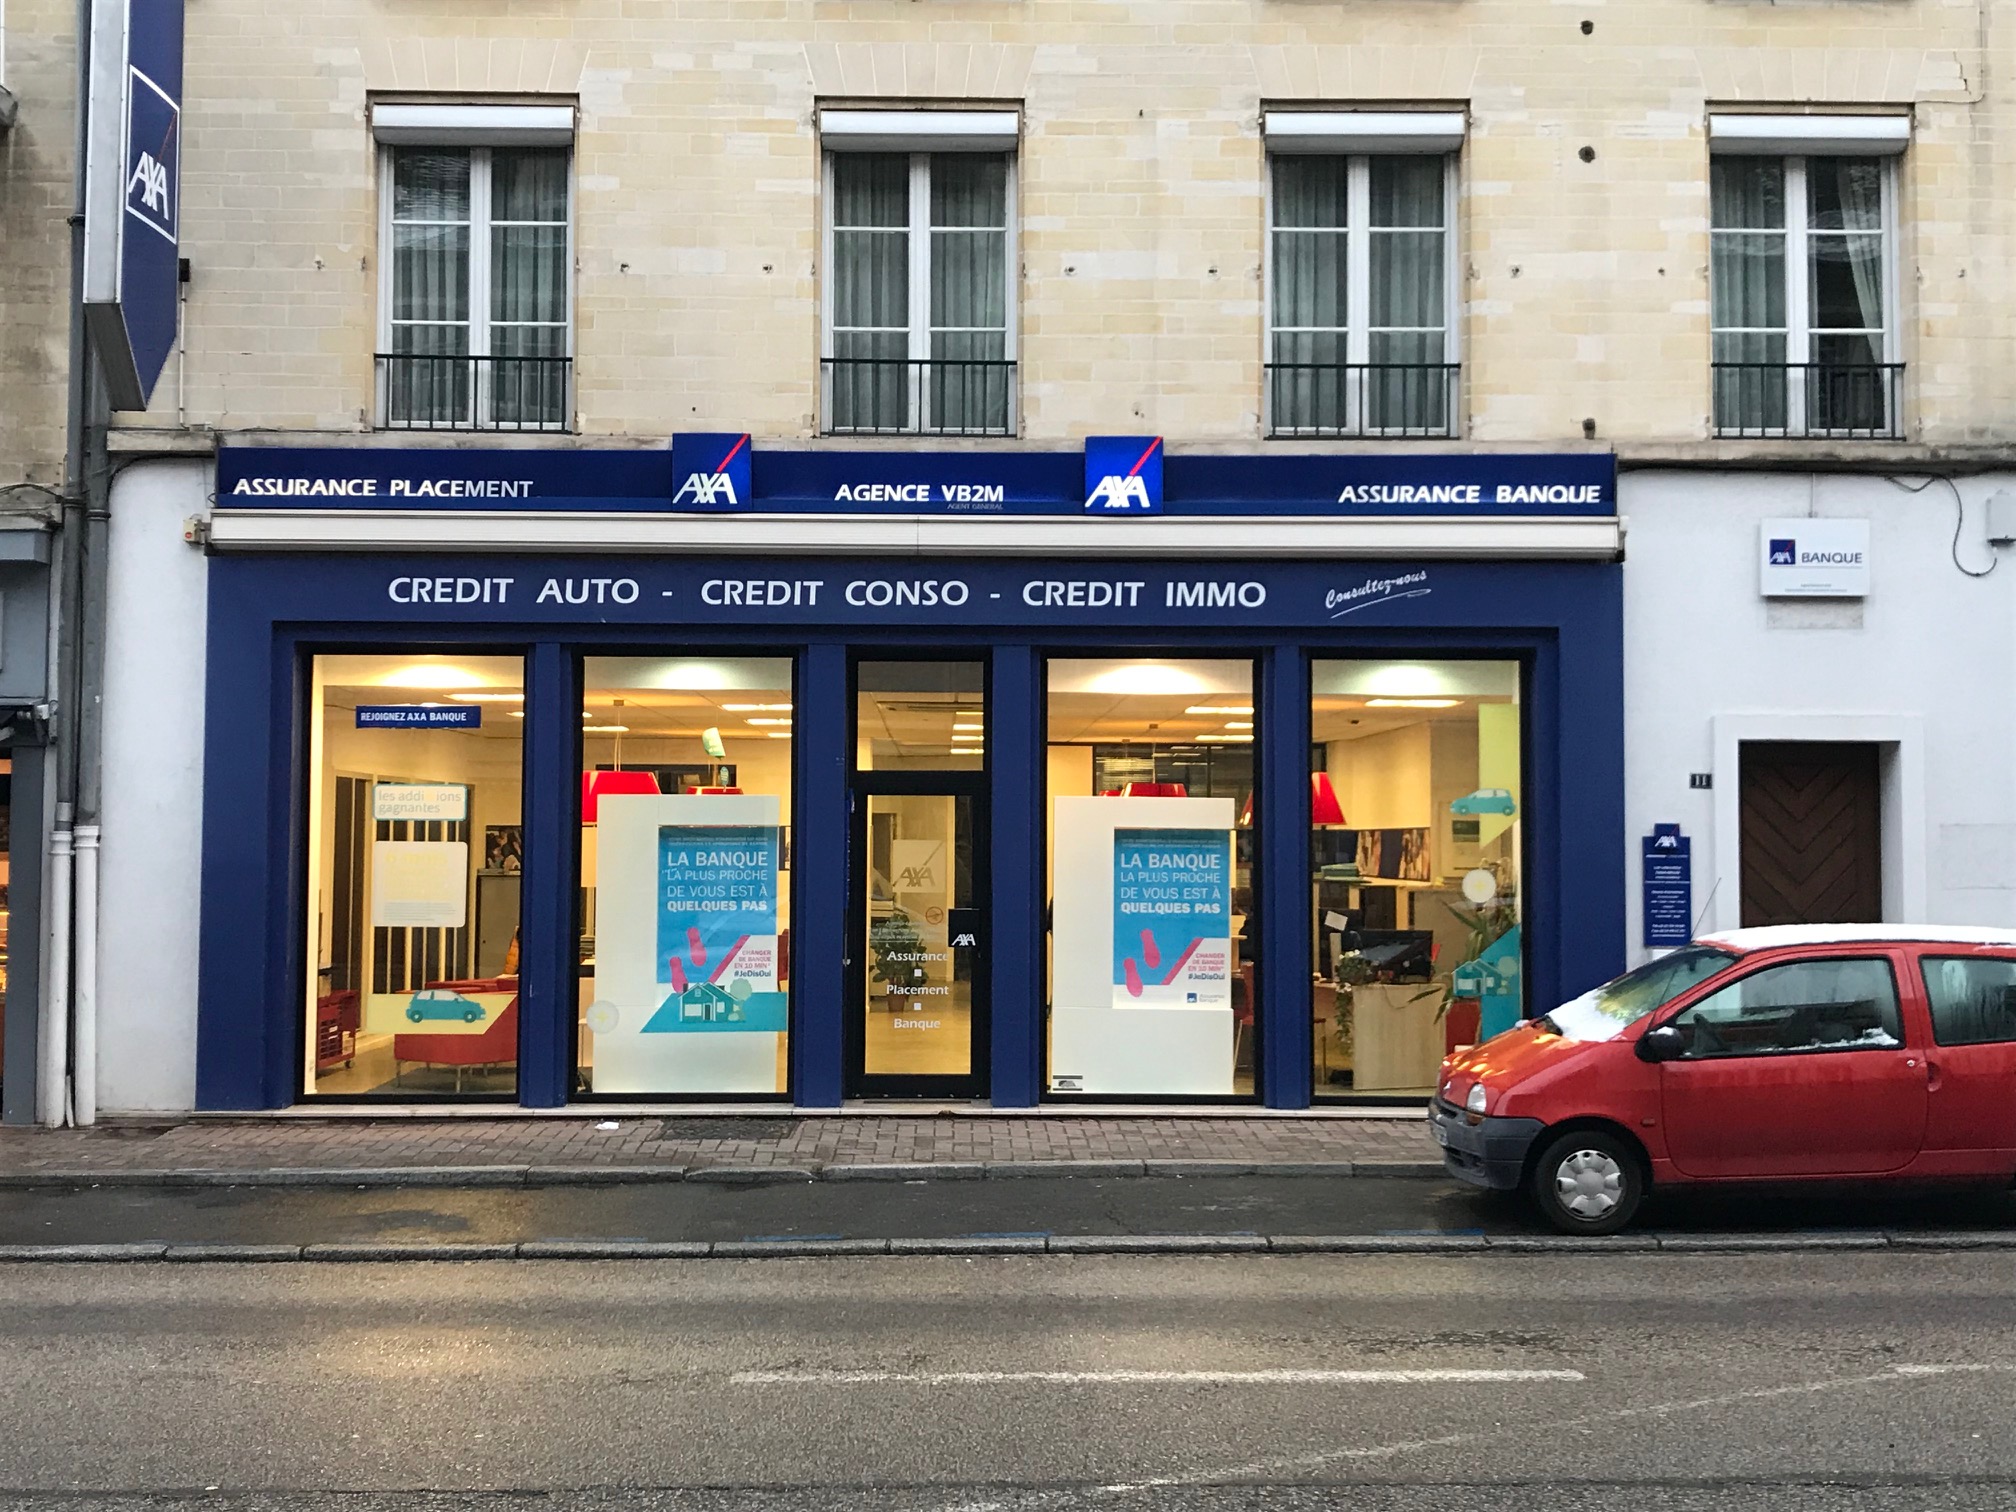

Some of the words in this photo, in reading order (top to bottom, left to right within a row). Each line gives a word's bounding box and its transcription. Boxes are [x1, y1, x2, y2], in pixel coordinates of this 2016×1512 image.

[128, 151, 170, 220] AXA
[233, 478, 377, 498] ASSURANCE
[390, 479, 533, 499] PLACEMENT
[673, 472, 738, 505] AXA
[834, 484, 930, 503] AGENCE
[941, 485, 1005, 503] VB2M
[1085, 475, 1151, 508] AXA
[1338, 484, 1481, 504] ASSURANCE
[1496, 484, 1601, 504] BANQUE
[1801, 552, 1863, 564] BANQUE
[388, 577, 515, 604] CREDIT
[536, 578, 640, 605] AUTO
[701, 579, 824, 606] CREDIT
[845, 580, 970, 607] CONSO
[1022, 581, 1145, 607] CREDIT
[1165, 581, 1267, 607] IMMO
[1325, 569, 1428, 610] Consultez-nous
[361, 712, 406, 722] REJOIGNEZ
[407, 712, 427, 722] AXA
[429, 712, 467, 722] BANQUE
[378, 790, 395, 801] les
[398, 790, 462, 802] addiions
[379, 802, 441, 815] gagnantes
[668, 852, 689, 867] LA
[696, 852, 768, 868] BANQUE
[1121, 853, 1142, 868] LA
[1149, 853, 1221, 871] BANQUE
[667, 870, 681, 881] LA
[685, 870, 716, 881] PLUS
[719, 870, 768, 881] PROCHE
[899, 866, 936, 887] AXA
[1121, 872, 1134, 882] LA
[1138, 872, 1169, 883] PLUS
[1173, 872, 1221, 883] PROCHE
[667, 885, 685, 897] DE
[689, 886, 726, 897] VOUS
[730, 886, 755, 897] EST
[759, 883, 768, 897] À
[1121, 887, 1138, 899] DE
[1142, 887, 1179, 899] VOUS
[1183, 888, 1208, 899] EST
[1212, 885, 1221, 899] À
[667, 900, 737, 912] QUELQUES
[742, 900, 768, 911] PAS
[1121, 902, 1191, 914] QUELQUES
[1195, 902, 1221, 914] PAS
[951, 933, 977, 947] AXA
[887, 950, 949, 962] Assurance
[734, 969, 772, 977] #JeDisOui
[886, 984, 949, 996] Placement
[893, 1018, 941, 1031] Banque
